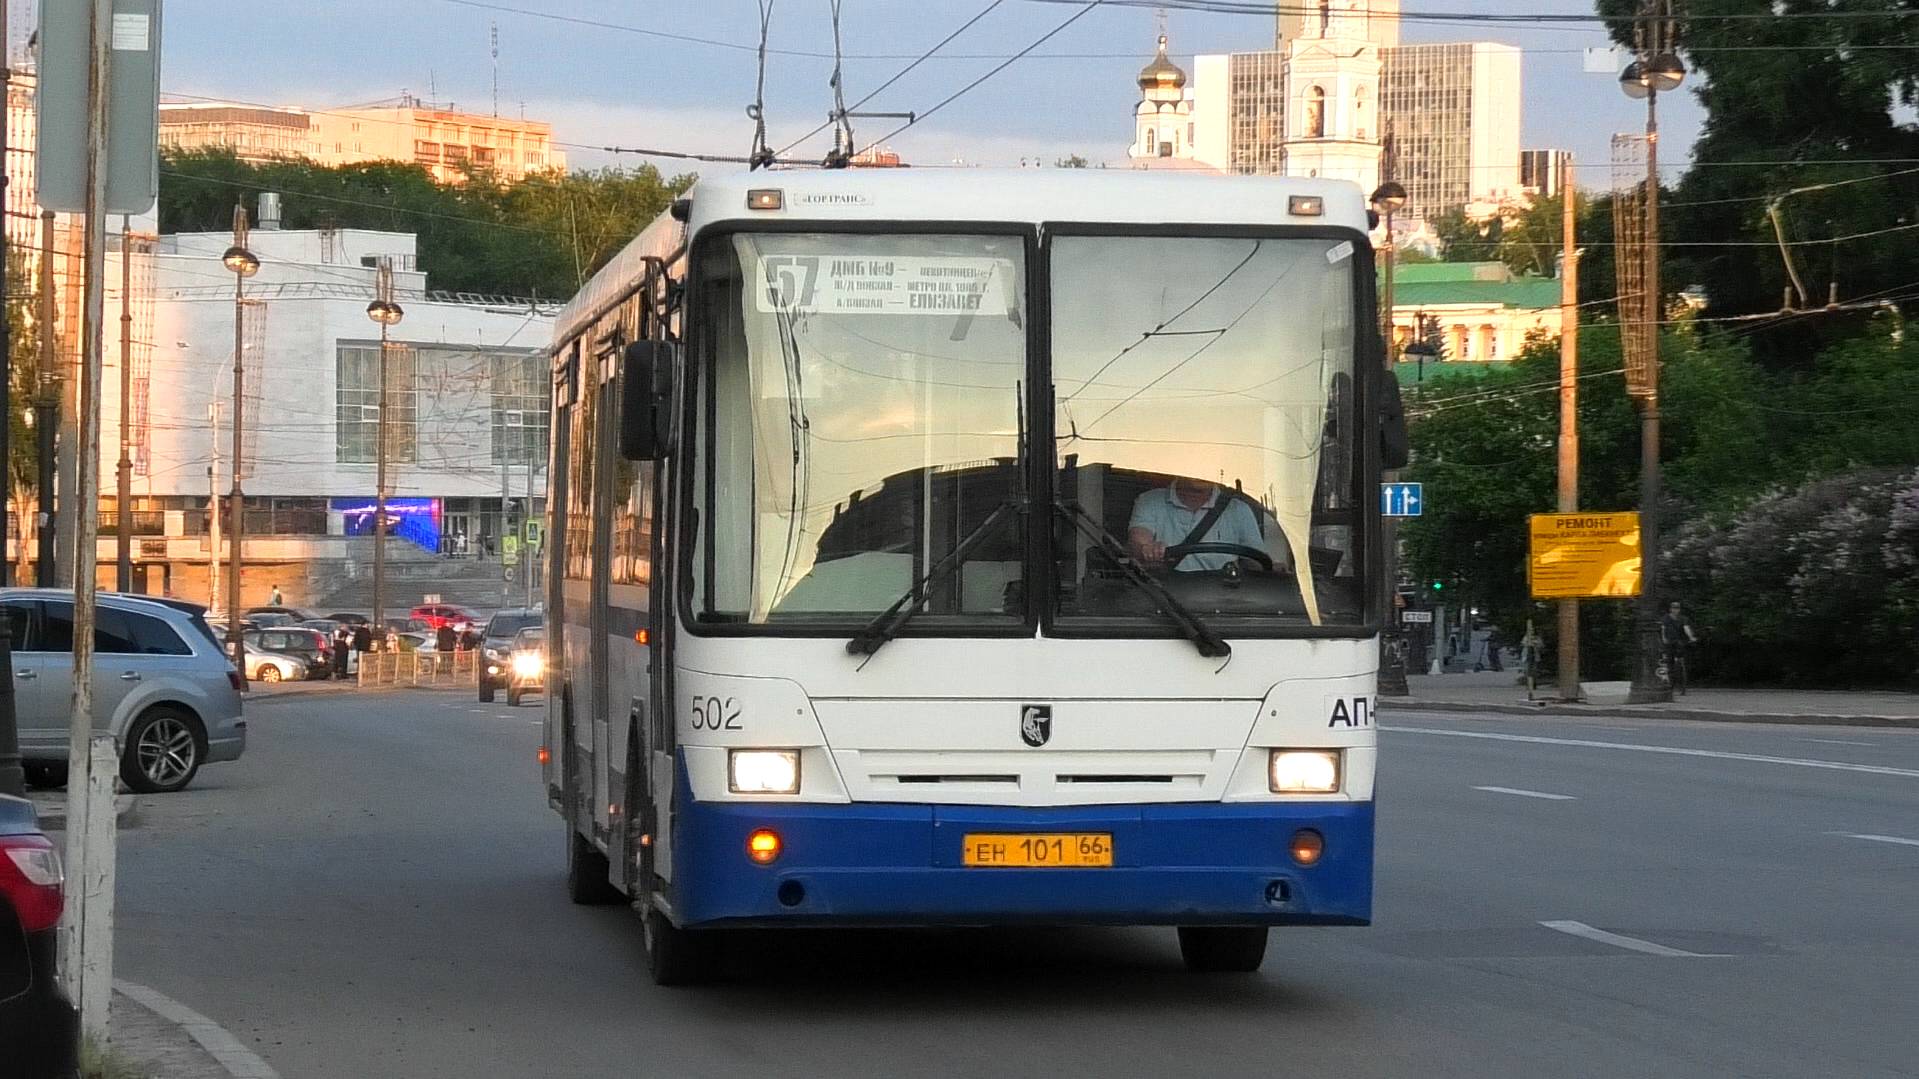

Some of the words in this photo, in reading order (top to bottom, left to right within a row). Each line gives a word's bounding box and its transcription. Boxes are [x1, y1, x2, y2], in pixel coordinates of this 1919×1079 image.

[766, 257, 819, 308] 57
[1556, 518, 1613, 529] РЕМОНТ
[692, 695, 743, 730] 502
[1328, 697, 1377, 727] АП-
[976, 843, 1005, 862] ЕН
[1020, 839, 1063, 862] 101
[1079, 837, 1103, 854] 66
